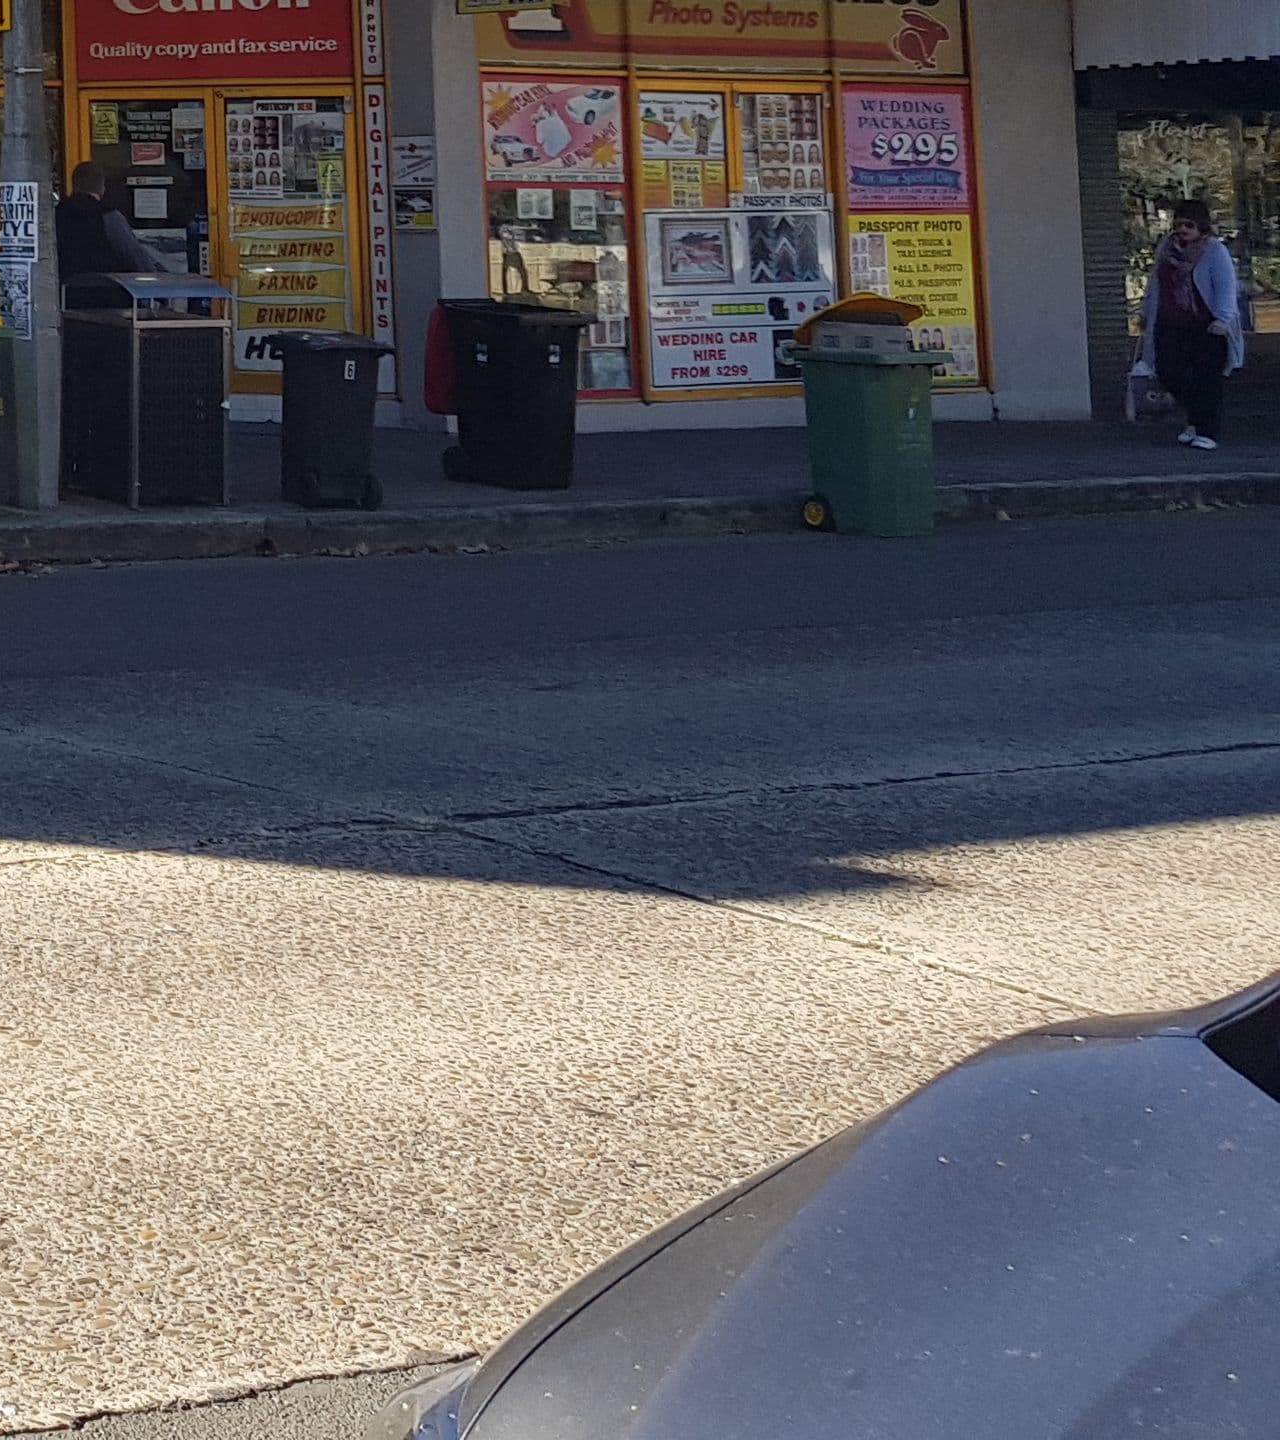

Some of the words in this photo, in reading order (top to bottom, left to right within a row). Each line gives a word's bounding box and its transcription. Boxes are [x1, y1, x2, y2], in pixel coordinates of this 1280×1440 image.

[722, 1, 819, 33] Systems
[366, 13, 378, 65] PHOTO
[90, 41, 153, 60] Quality
[155, 42, 199, 59] copy
[201, 38, 236, 54] and
[239, 37, 266, 53] fax
[269, 36, 338, 52] service
[860, 99, 945, 114] WEDDING
[857, 116, 951, 130] PACKAGES
[368, 93, 383, 214] DIGITAL
[871, 131, 959, 167] $295
[743, 195, 787, 207] PASSPORT
[858, 221, 920, 233] PASSPORT
[923, 220, 963, 232] PHOTO
[933, 263, 963, 272] PHOTO
[257, 274, 319, 291] FAXING
[374, 225, 390, 329] PRINTS
[917, 278, 963, 288] PASSPORT
[255, 307, 327, 324] BINDING
[938, 308, 967, 317] PHOTO
[657, 333, 724, 347] WEDDING
[729, 331, 758, 344] CAR
[693, 348, 727, 362] HIRE
[345, 361, 355, 380] 6
[671, 366, 711, 379] FROM
[716, 364, 749, 377] $299
